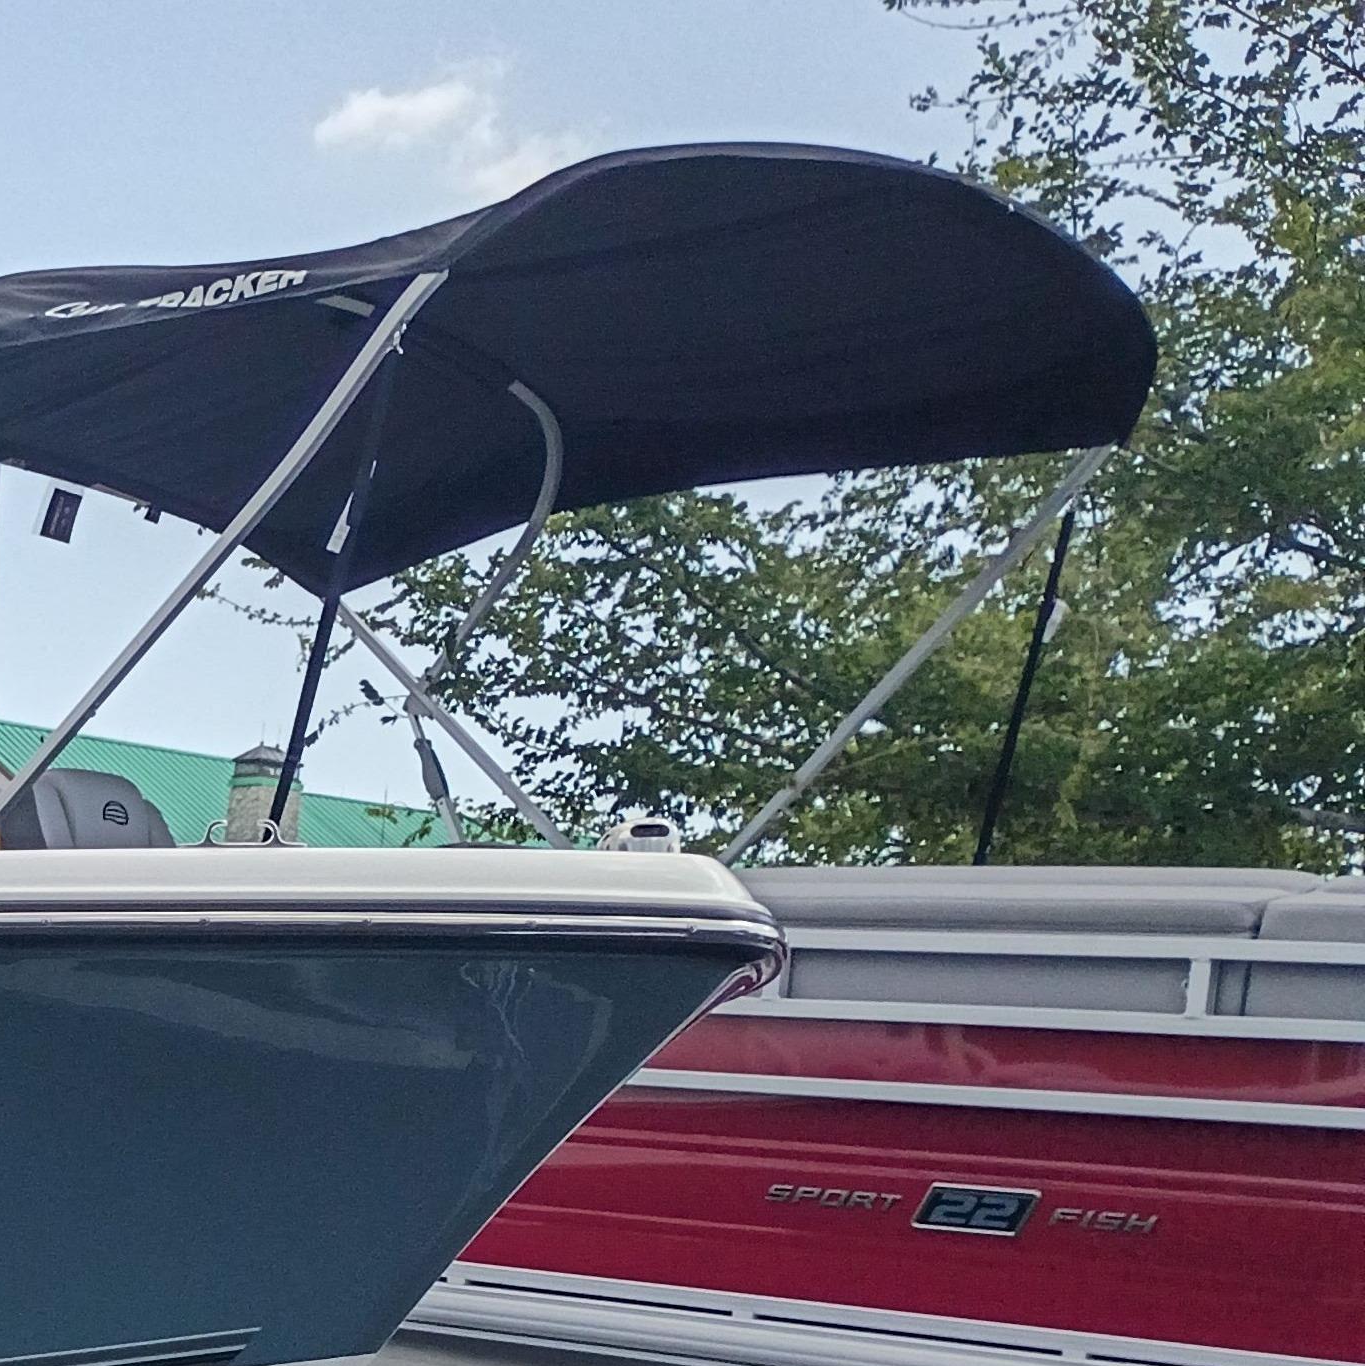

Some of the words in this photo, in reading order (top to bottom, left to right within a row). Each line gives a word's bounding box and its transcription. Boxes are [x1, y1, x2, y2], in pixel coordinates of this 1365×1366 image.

[765, 1184, 902, 1209] SPORT
[929, 1193, 1023, 1229] 22
[1048, 1207, 1159, 1233] FISH
